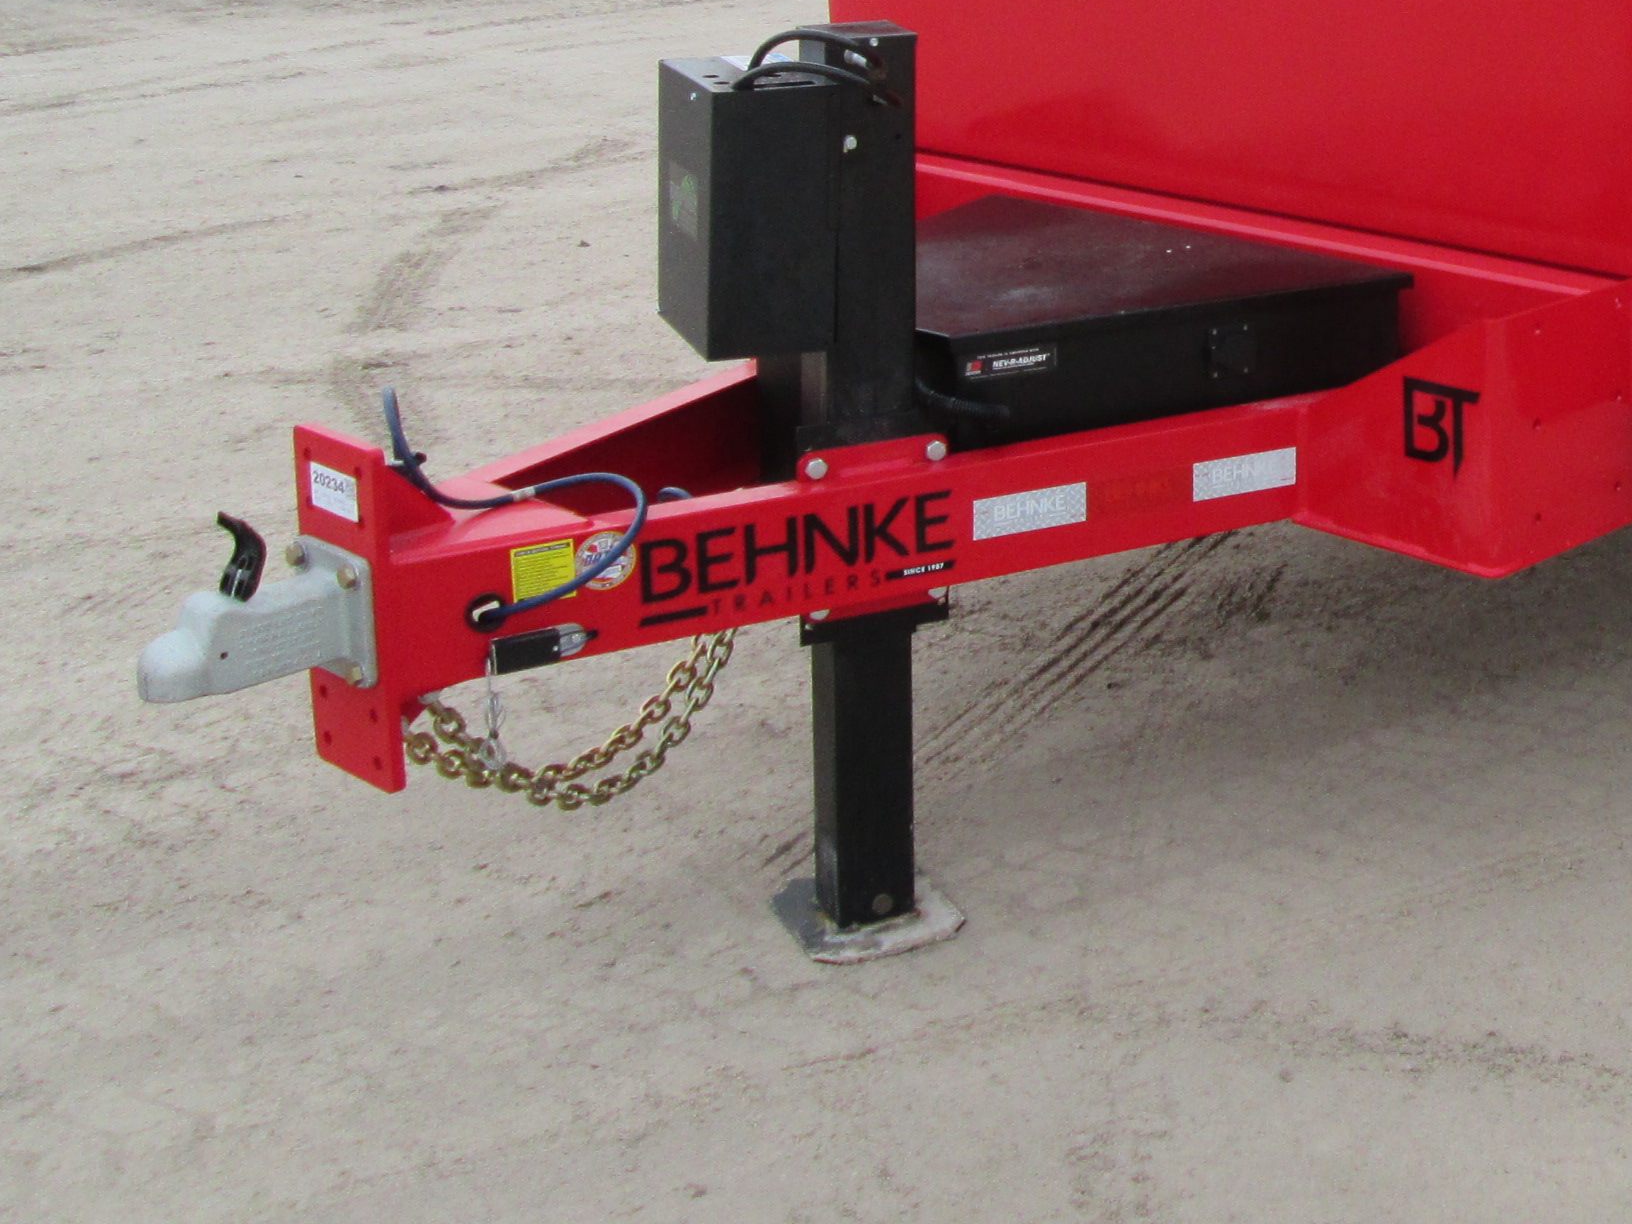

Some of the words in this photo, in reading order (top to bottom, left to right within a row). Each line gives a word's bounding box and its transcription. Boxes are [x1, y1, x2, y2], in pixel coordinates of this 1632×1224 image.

[992, 354, 1048, 368] NEV-R-ADJUST
[1403, 376, 1480, 480] BT
[312, 470, 345, 494] 20234
[993, 493, 1067, 522] BEHNKE
[639, 489, 956, 605] BEHNKE
[903, 565, 925, 576] SINCE
[711, 568, 882, 615] TRAILERS
